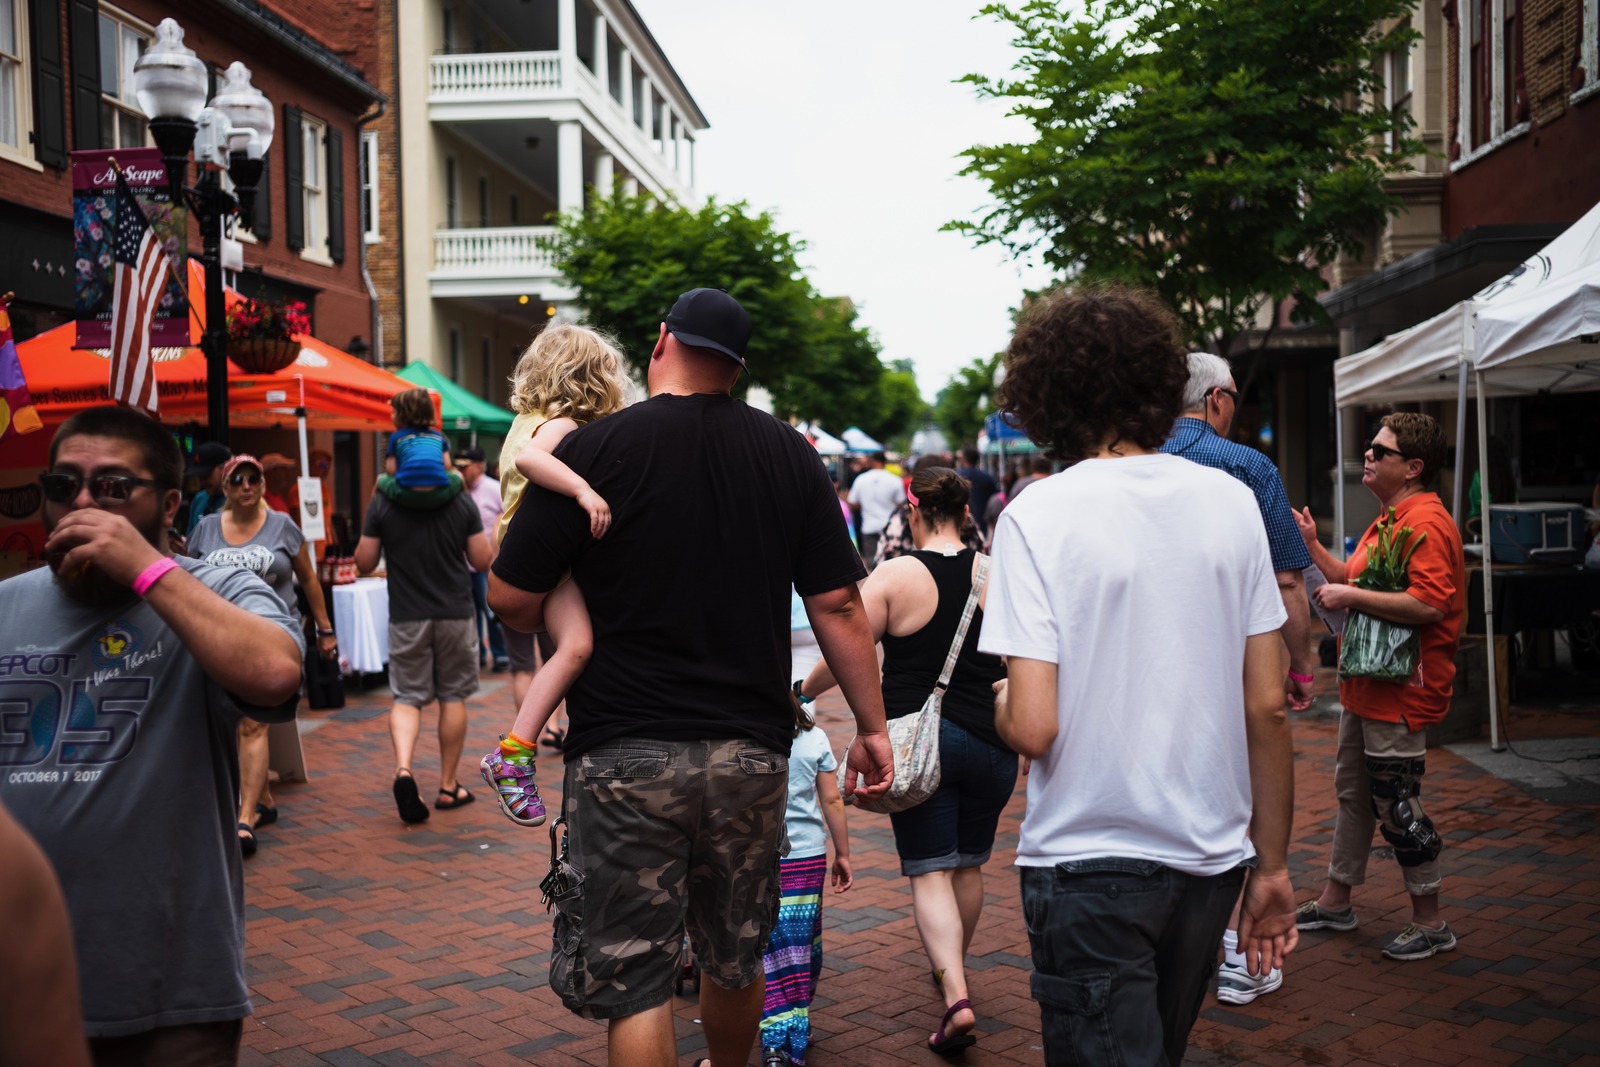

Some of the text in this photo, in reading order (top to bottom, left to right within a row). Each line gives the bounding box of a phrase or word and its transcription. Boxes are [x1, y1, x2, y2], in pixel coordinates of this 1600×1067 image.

[93, 165, 164, 185] ArScape
[157, 380, 188, 399] Mary
[0, 654, 77, 677] EPCOT
[94, 667, 120, 687] Was
[123, 641, 163, 670] There!
[0, 677, 153, 766] 35
[9, 769, 102, 783] OCTOBER 1 2017
